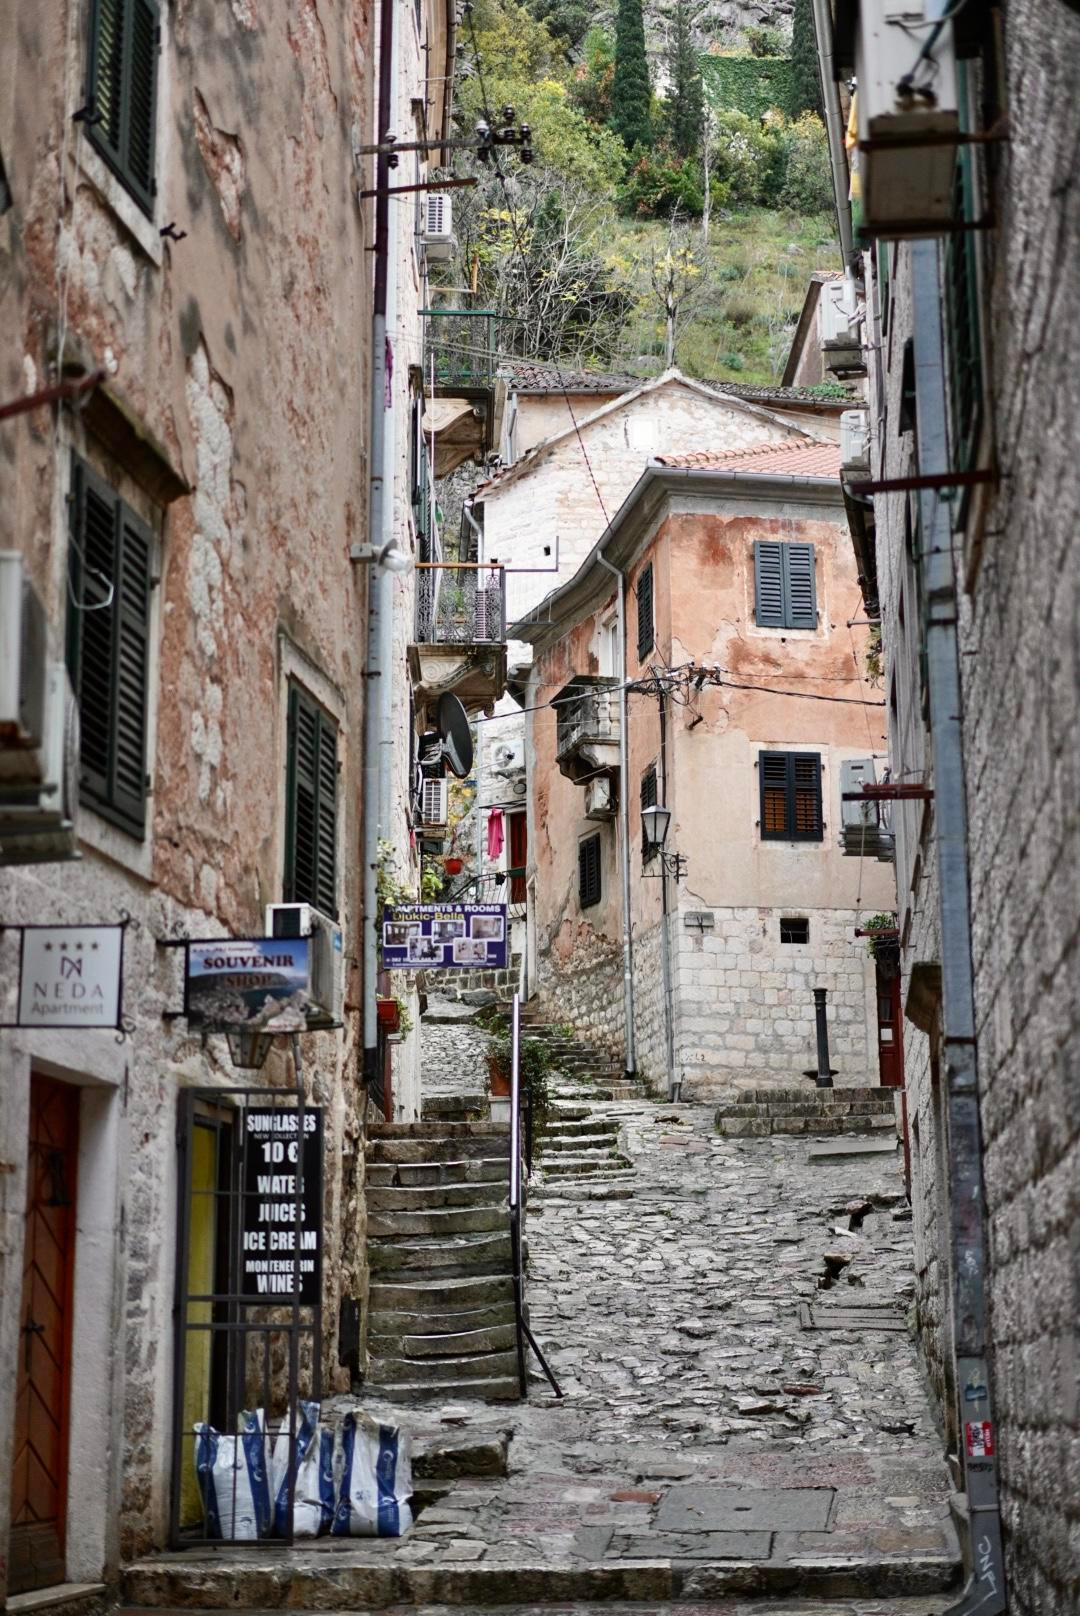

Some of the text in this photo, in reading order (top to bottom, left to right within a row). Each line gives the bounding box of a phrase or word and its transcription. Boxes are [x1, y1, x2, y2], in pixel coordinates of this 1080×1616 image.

[203, 955, 294, 969] SOUVENIR
[226, 975, 272, 988] SHOP
[33, 982, 104, 999] NEDA
[31, 1002, 104, 1016] Apartment
[261, 1142, 284, 1163] 10
[243, 1231, 266, 1250] ICE
